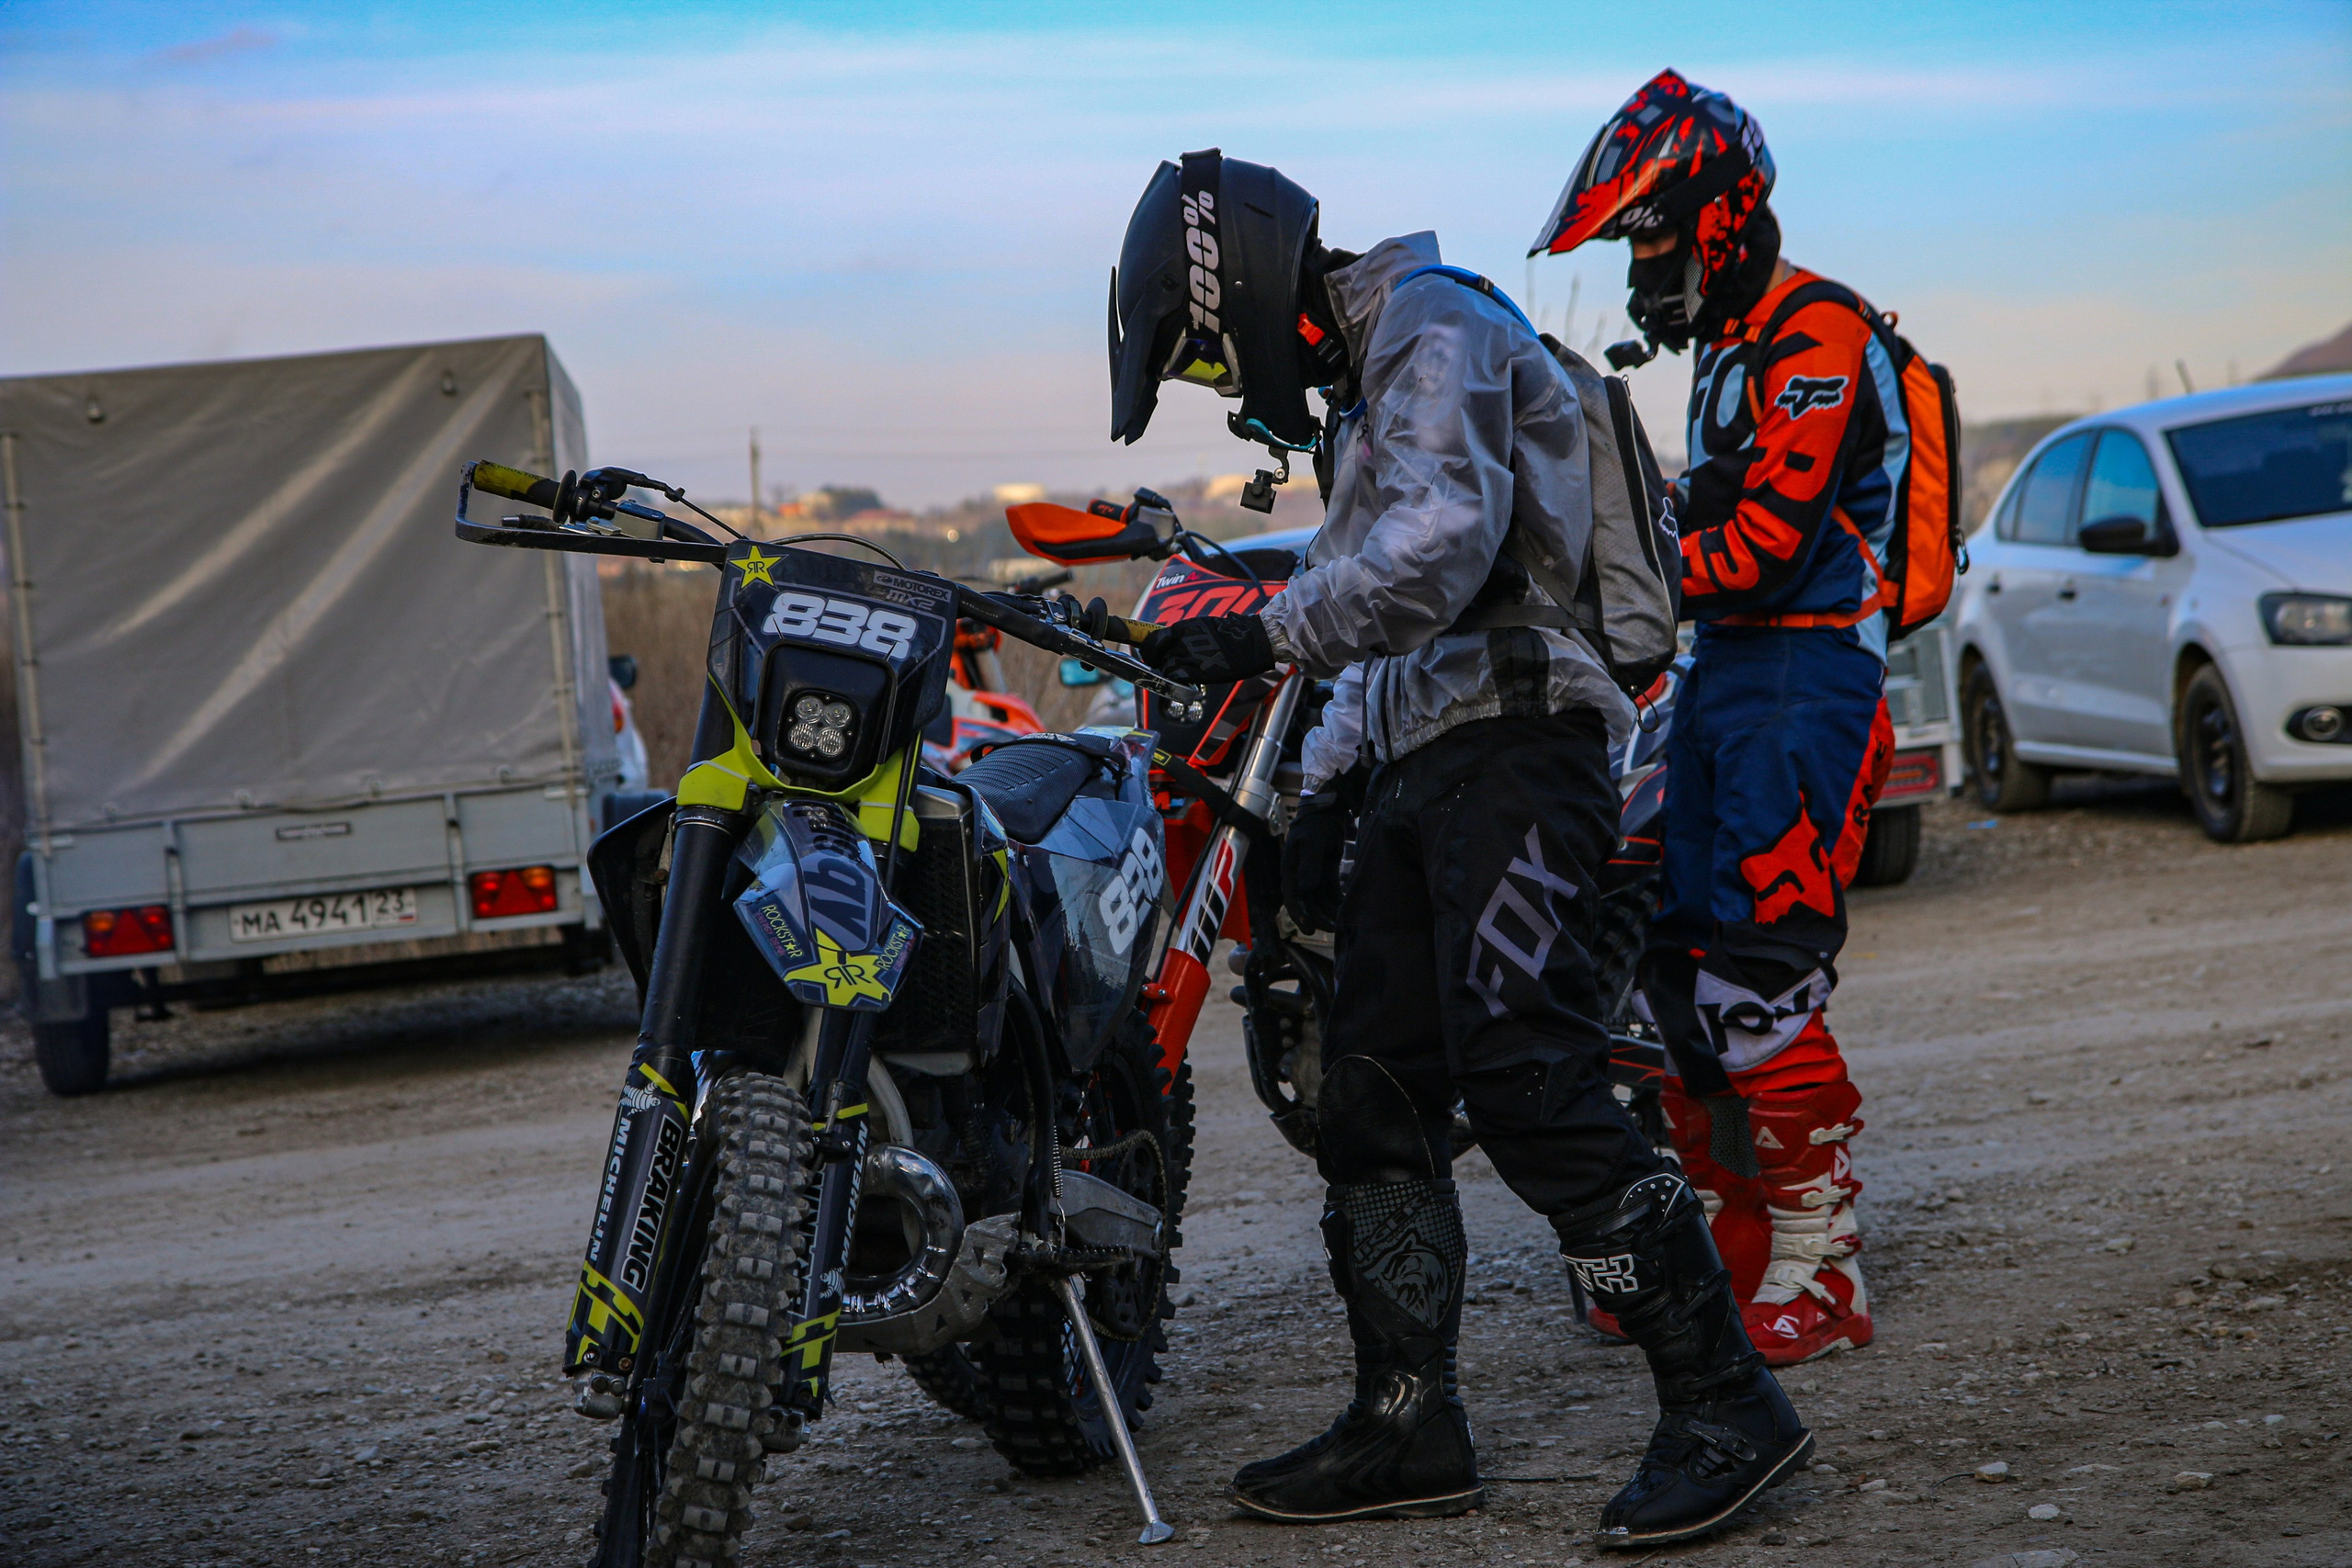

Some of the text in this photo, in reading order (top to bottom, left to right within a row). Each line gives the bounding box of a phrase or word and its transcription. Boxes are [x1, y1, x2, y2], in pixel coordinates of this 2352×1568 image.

[1182, 190, 1220, 334] 100%
[763, 592, 917, 660] 838
[893, 578, 950, 600] MOTOREX
[1156, 573, 1185, 589] Twin
[290, 894, 367, 930] 4941
[376, 890, 404, 915] 23
[1099, 827, 1165, 955] 838
[1466, 822, 1578, 1018] FOX
[586, 1116, 632, 1261] MICHELIN
[620, 1113, 685, 1294] BRAKING
[841, 1120, 869, 1269] MICHELIN
